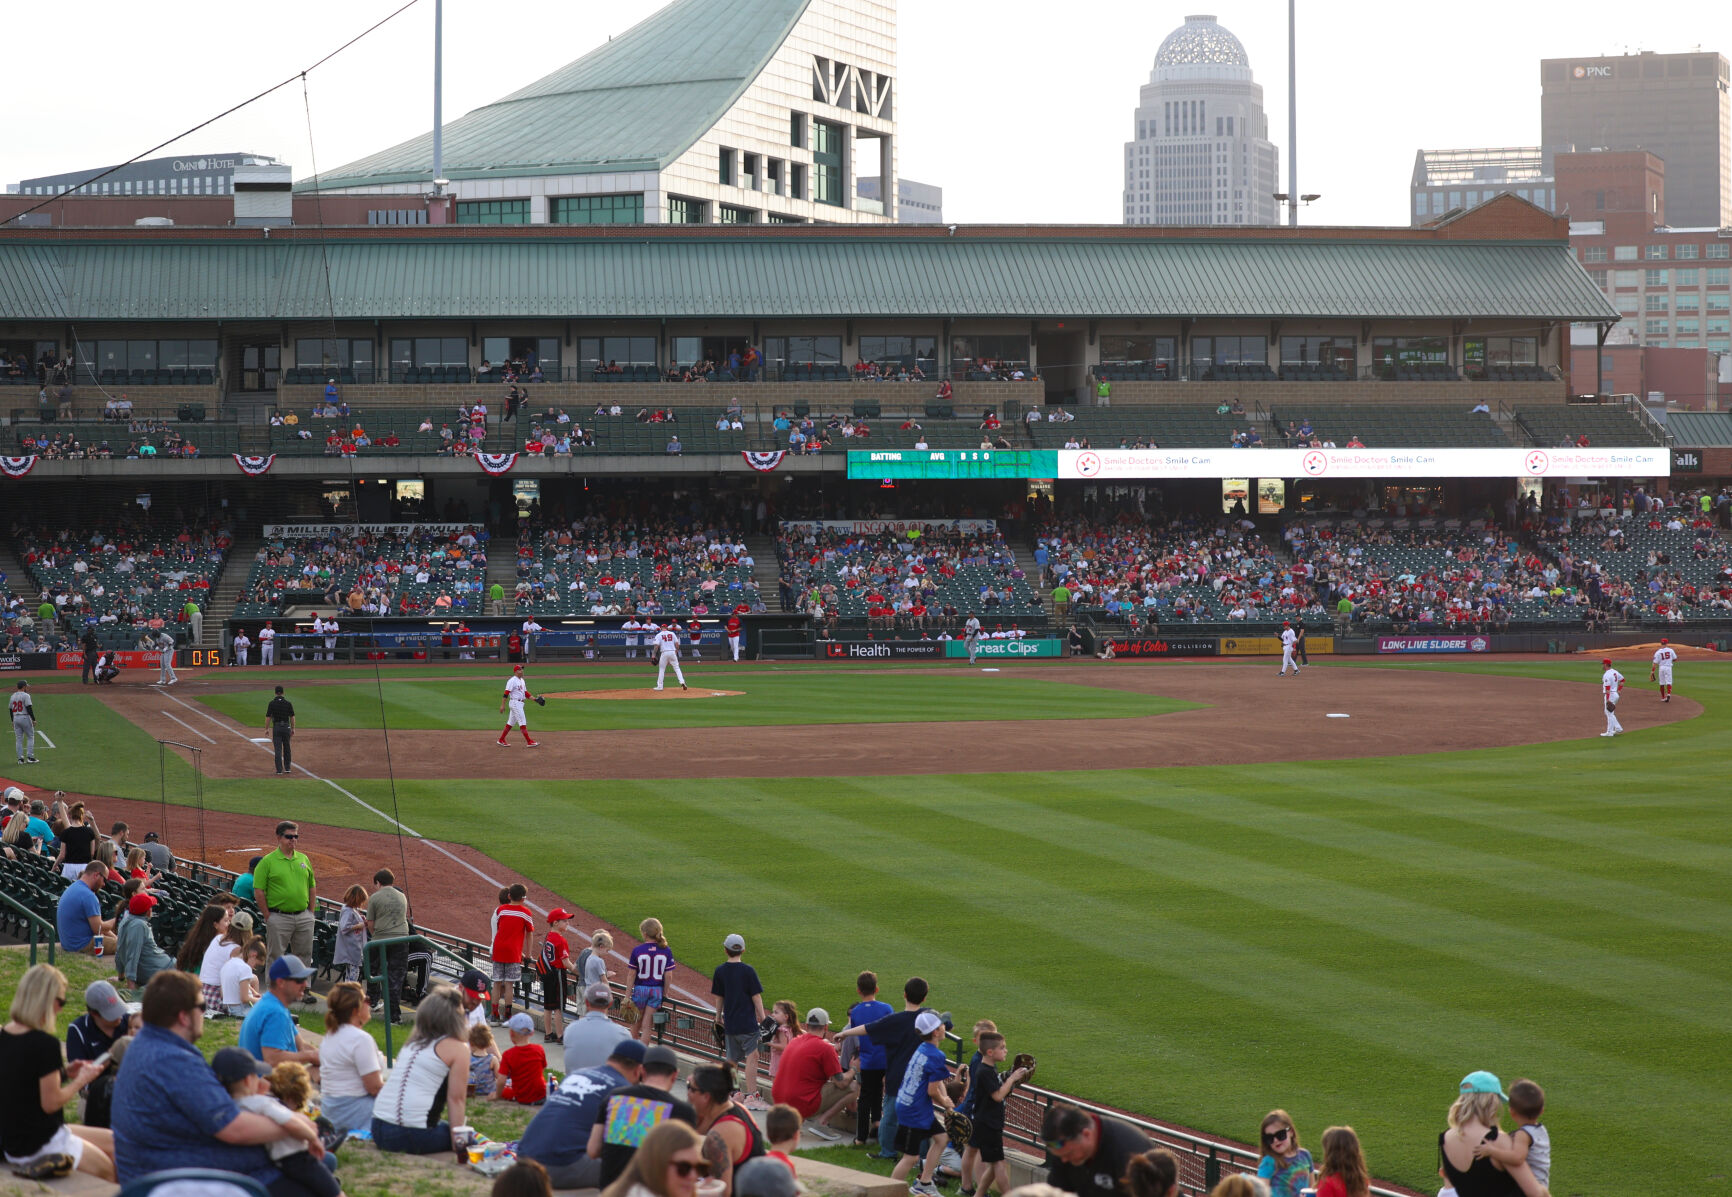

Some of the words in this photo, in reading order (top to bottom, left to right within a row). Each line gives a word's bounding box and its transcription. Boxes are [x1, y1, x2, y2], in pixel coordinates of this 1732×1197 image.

[1586, 66, 1612, 77] PNC
[870, 452, 902, 461] BATTING
[930, 452, 945, 460] AVG
[960, 452, 967, 460] B
[972, 452, 978, 460] S
[1103, 456, 1127, 465] Smile
[1128, 456, 1164, 465] Doctors
[1165, 456, 1189, 465] Smile
[1191, 456, 1211, 465] Cam
[1330, 455, 1353, 464] Smile
[1354, 455, 1389, 464] Doctors
[1390, 455, 1413, 464] Smile
[1415, 455, 1436, 464] Cam
[1551, 454, 1574, 463] Smile
[1575, 454, 1609, 463] Doctors
[1610, 454, 1633, 463] Smile
[1635, 455, 1654, 463] Cam
[661, 634, 673, 642] 49
[1007, 641, 1038, 656] Clips
[1382, 640, 1406, 650] LONG
[1407, 640, 1429, 649] LIVE
[1429, 640, 1467, 649] SLIDERS
[850, 643, 891, 657] Health
[12, 700, 24, 712] 28
[637, 954, 667, 980] 00
